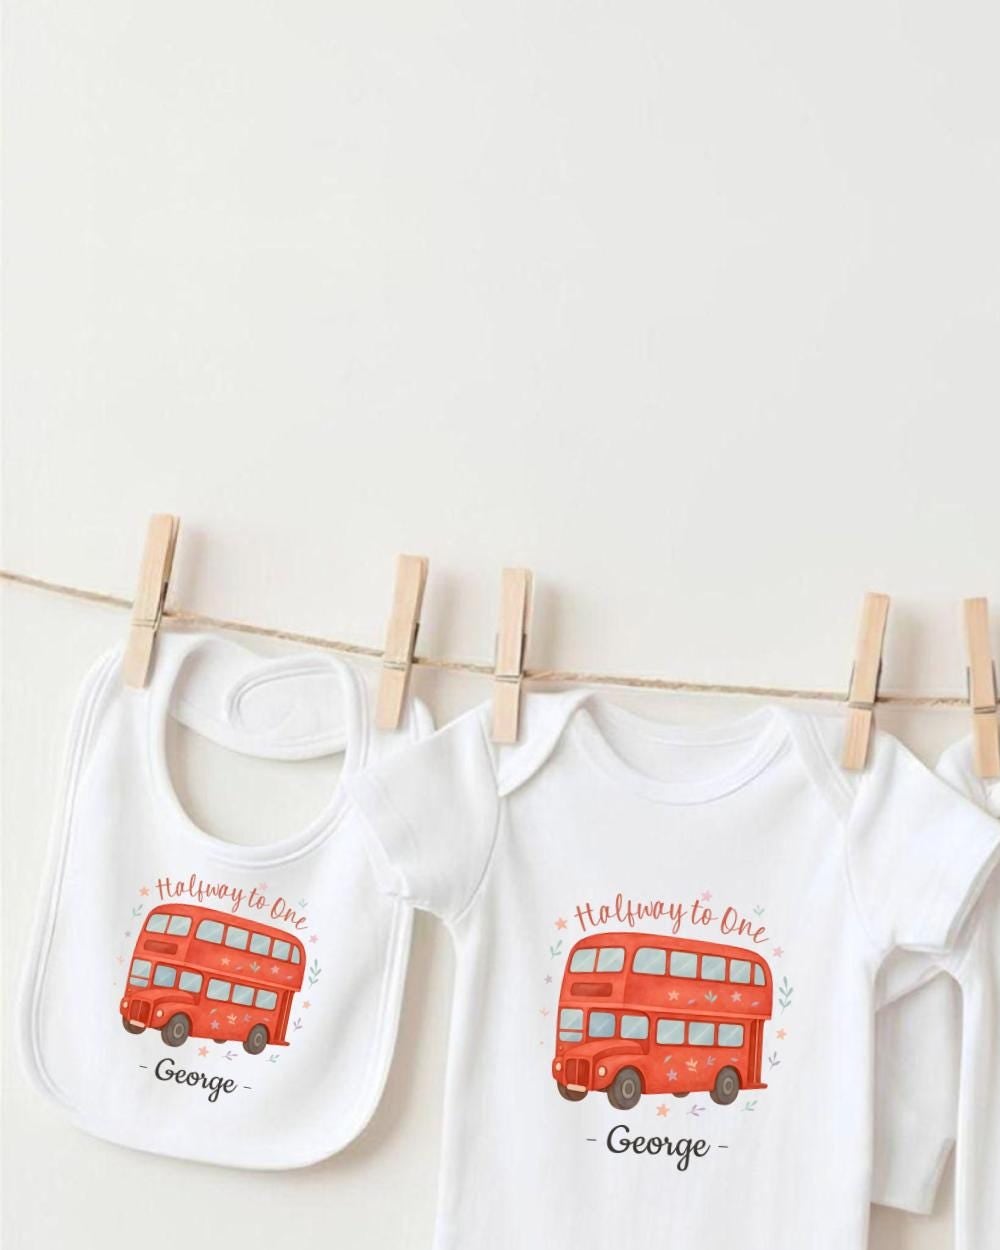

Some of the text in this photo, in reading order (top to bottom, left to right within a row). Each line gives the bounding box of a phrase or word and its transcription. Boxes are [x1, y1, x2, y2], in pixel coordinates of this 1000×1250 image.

[155, 873, 309, 930] Halfway to One
[573, 893, 770, 944] Halfway to One
[154, 1057, 238, 1103] George
[606, 1124, 711, 1172] George
